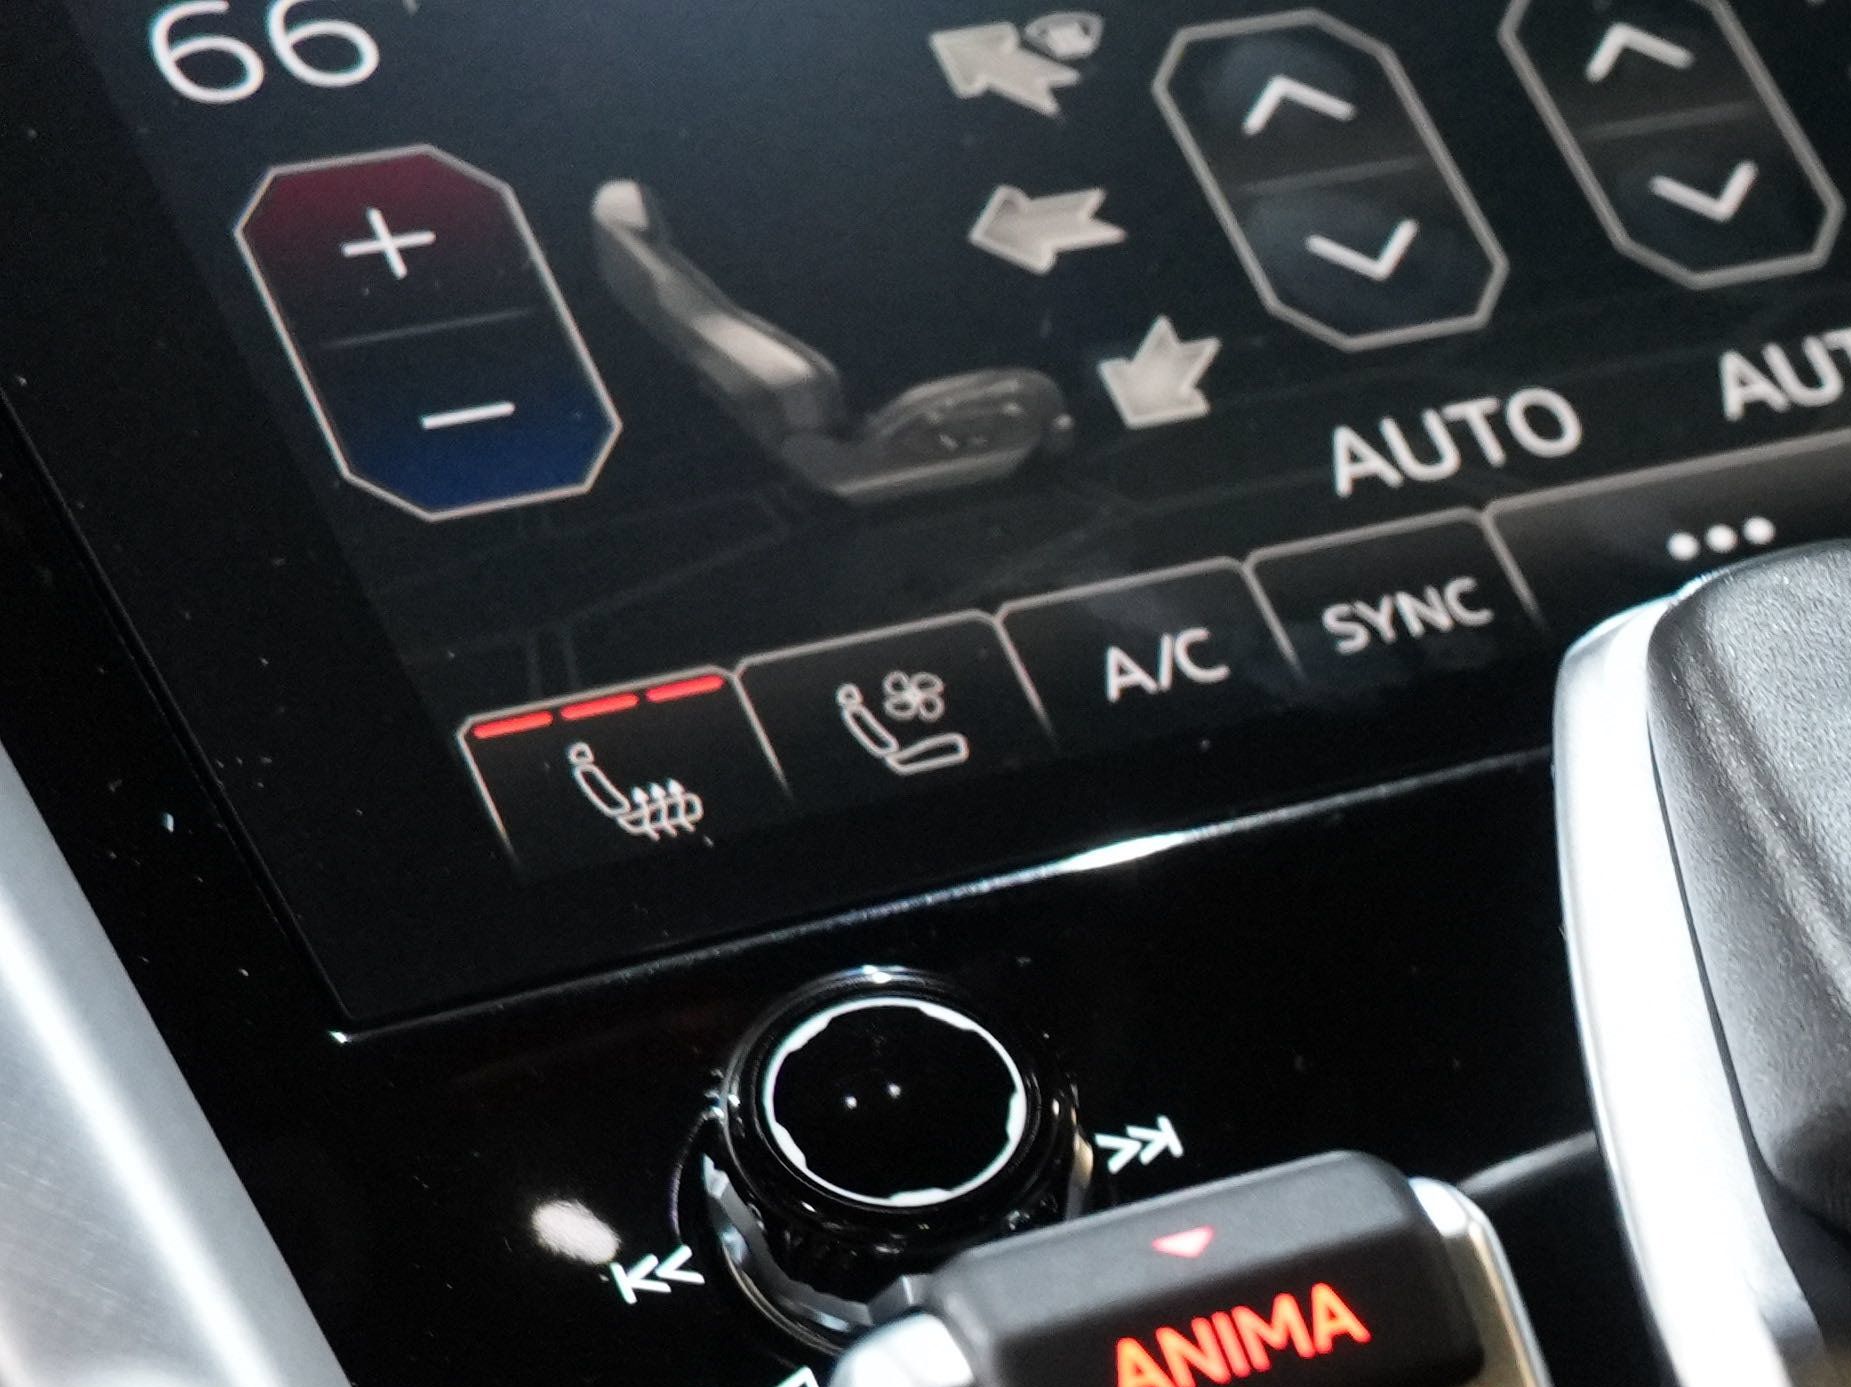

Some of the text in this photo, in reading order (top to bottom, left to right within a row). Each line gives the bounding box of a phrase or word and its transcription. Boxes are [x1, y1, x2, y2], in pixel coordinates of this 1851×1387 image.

[147, 0, 380, 104] 66
[1331, 386, 1584, 499] AUTO
[1320, 576, 1494, 656] SYNC
[1103, 625, 1232, 704] A/C
